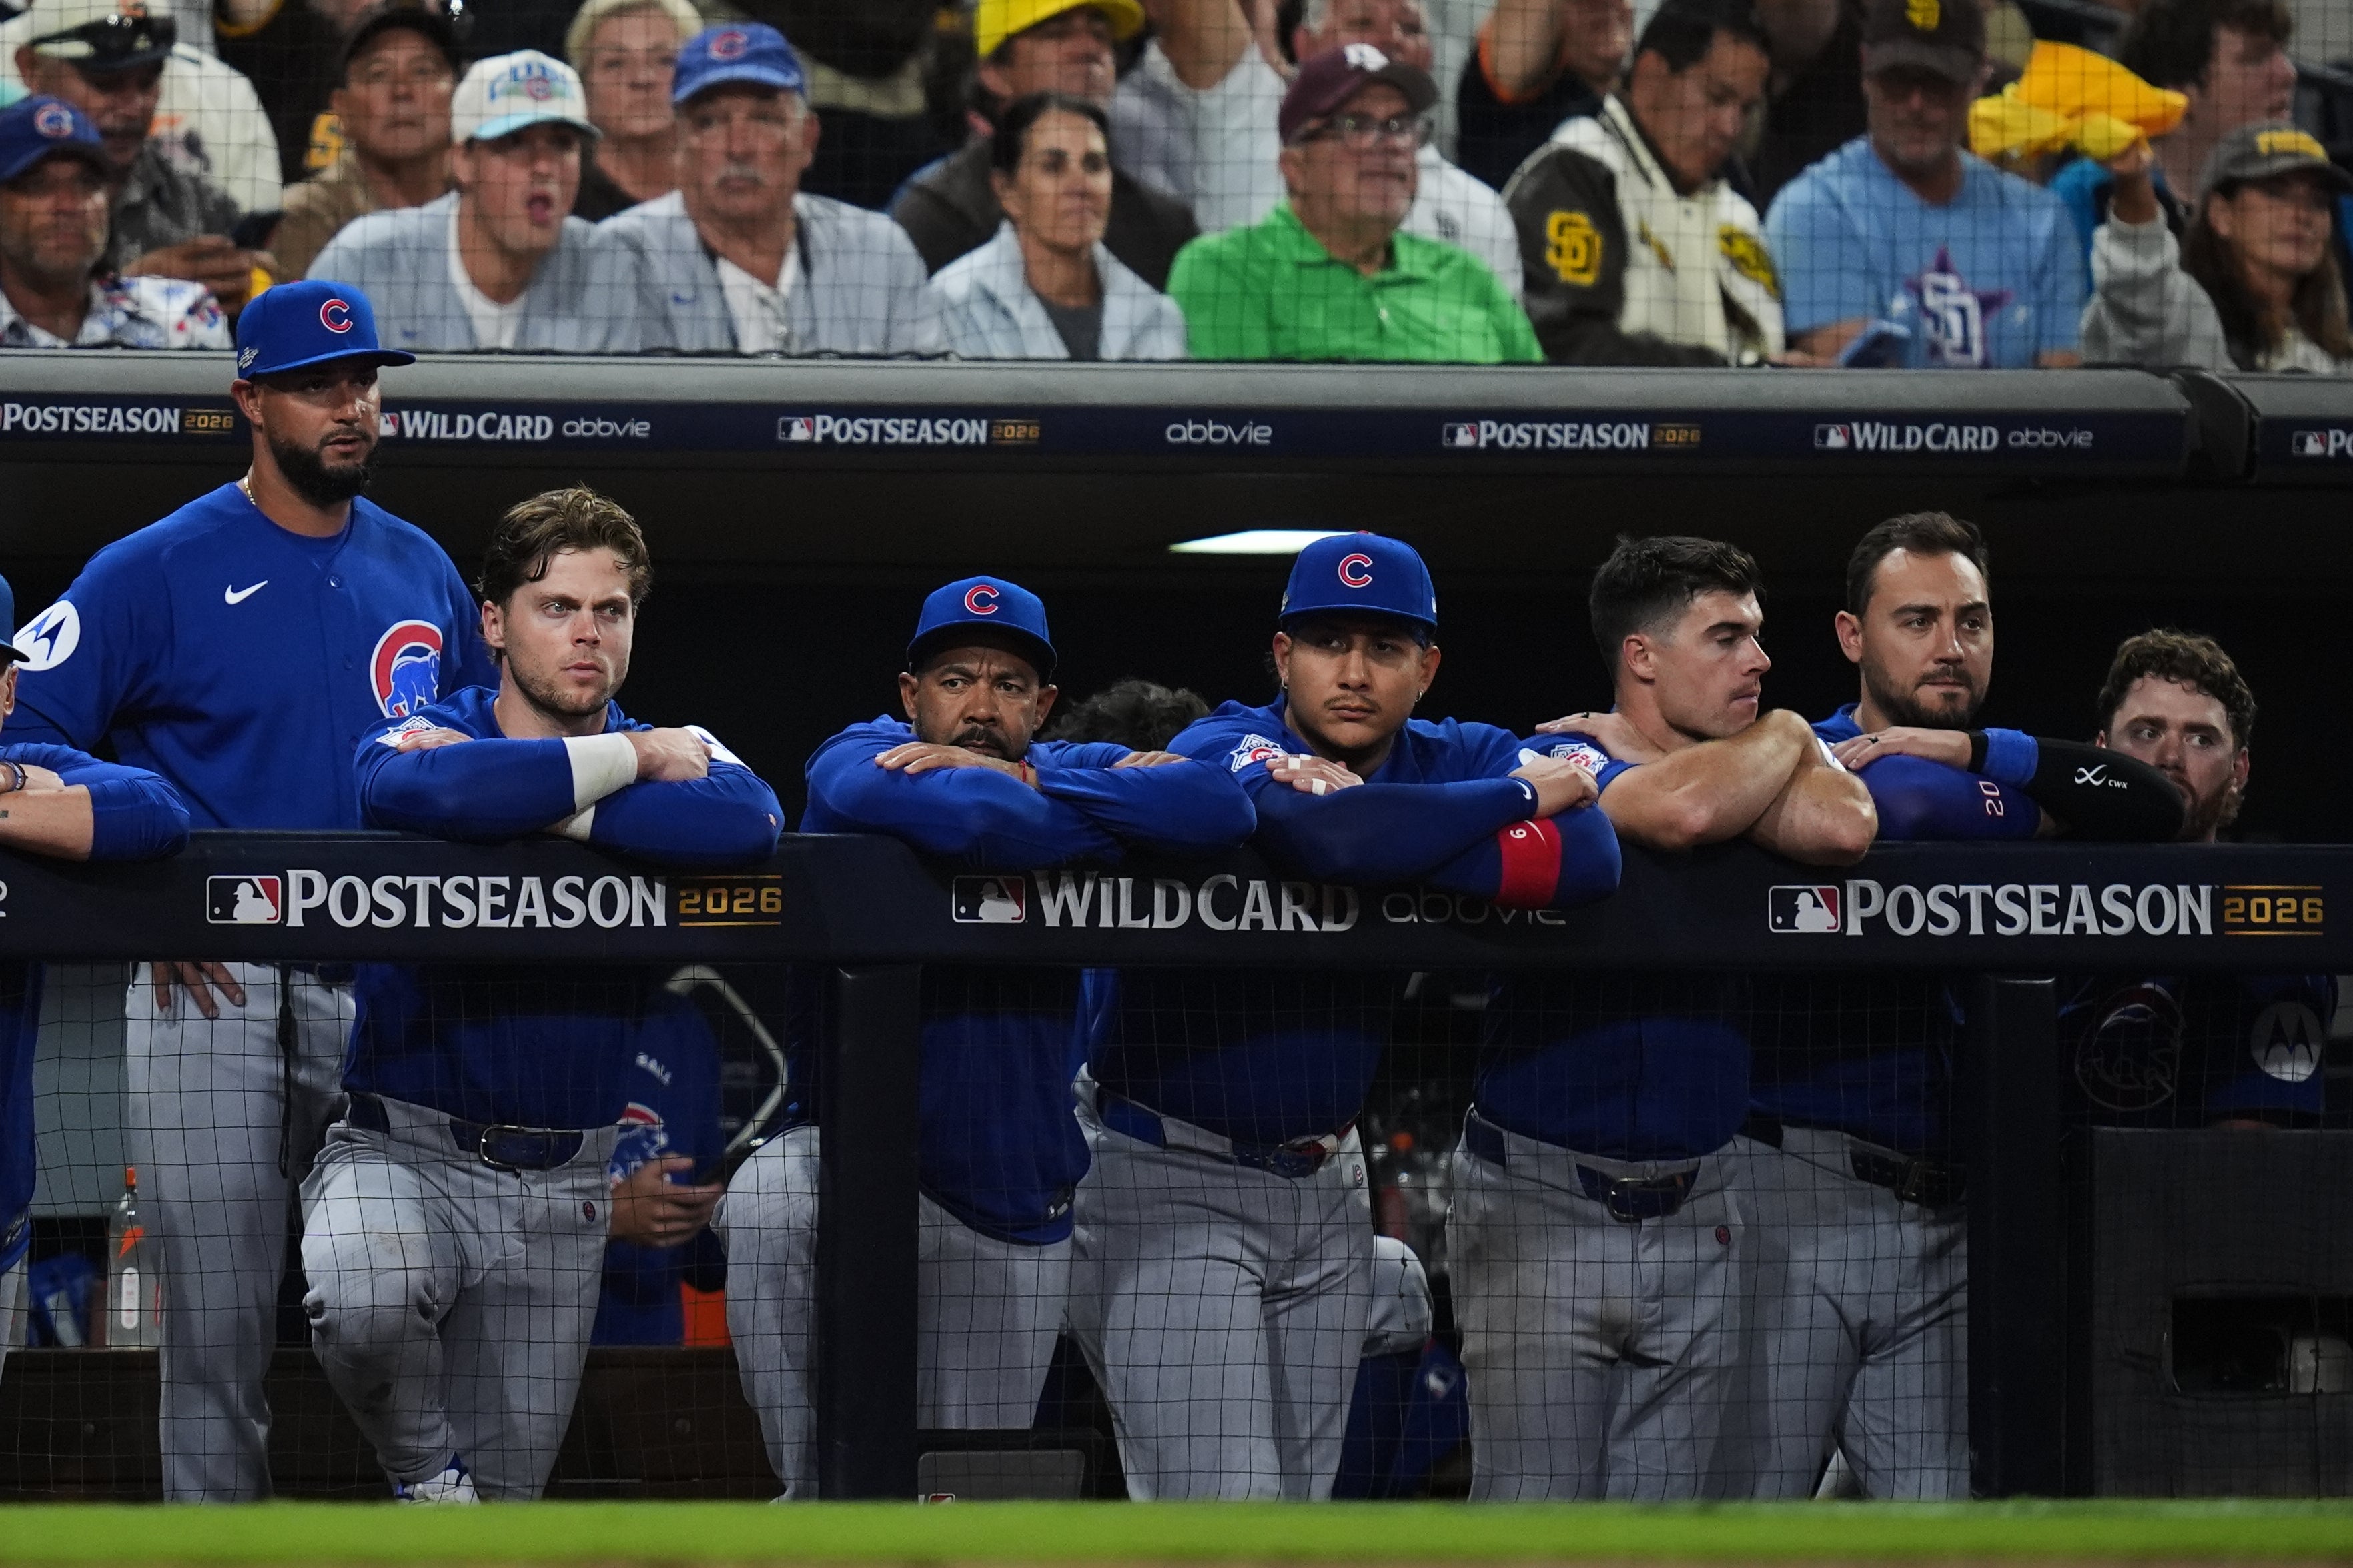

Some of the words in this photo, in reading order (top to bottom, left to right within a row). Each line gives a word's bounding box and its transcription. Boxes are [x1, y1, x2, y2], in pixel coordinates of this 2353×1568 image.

[320, 299, 353, 333] C
[2, 403, 180, 432] POSTSEASON
[185, 414, 233, 428] 2026
[562, 410, 651, 437] abbvie
[814, 415, 988, 445] POSTSEASON
[992, 424, 1040, 439] 2026
[1165, 419, 1272, 444] abbvie
[1478, 420, 1650, 449] POSTSEASON
[2007, 426, 2094, 448] abbvie
[1338, 553, 1373, 588] C
[965, 585, 999, 614] C
[1979, 781, 2004, 816] 20
[286, 870, 667, 928] POSTSEASON
[678, 886, 782, 914] 2026
[1845, 879, 2213, 936] POSTSEASON
[2224, 897, 2324, 923] 2026
